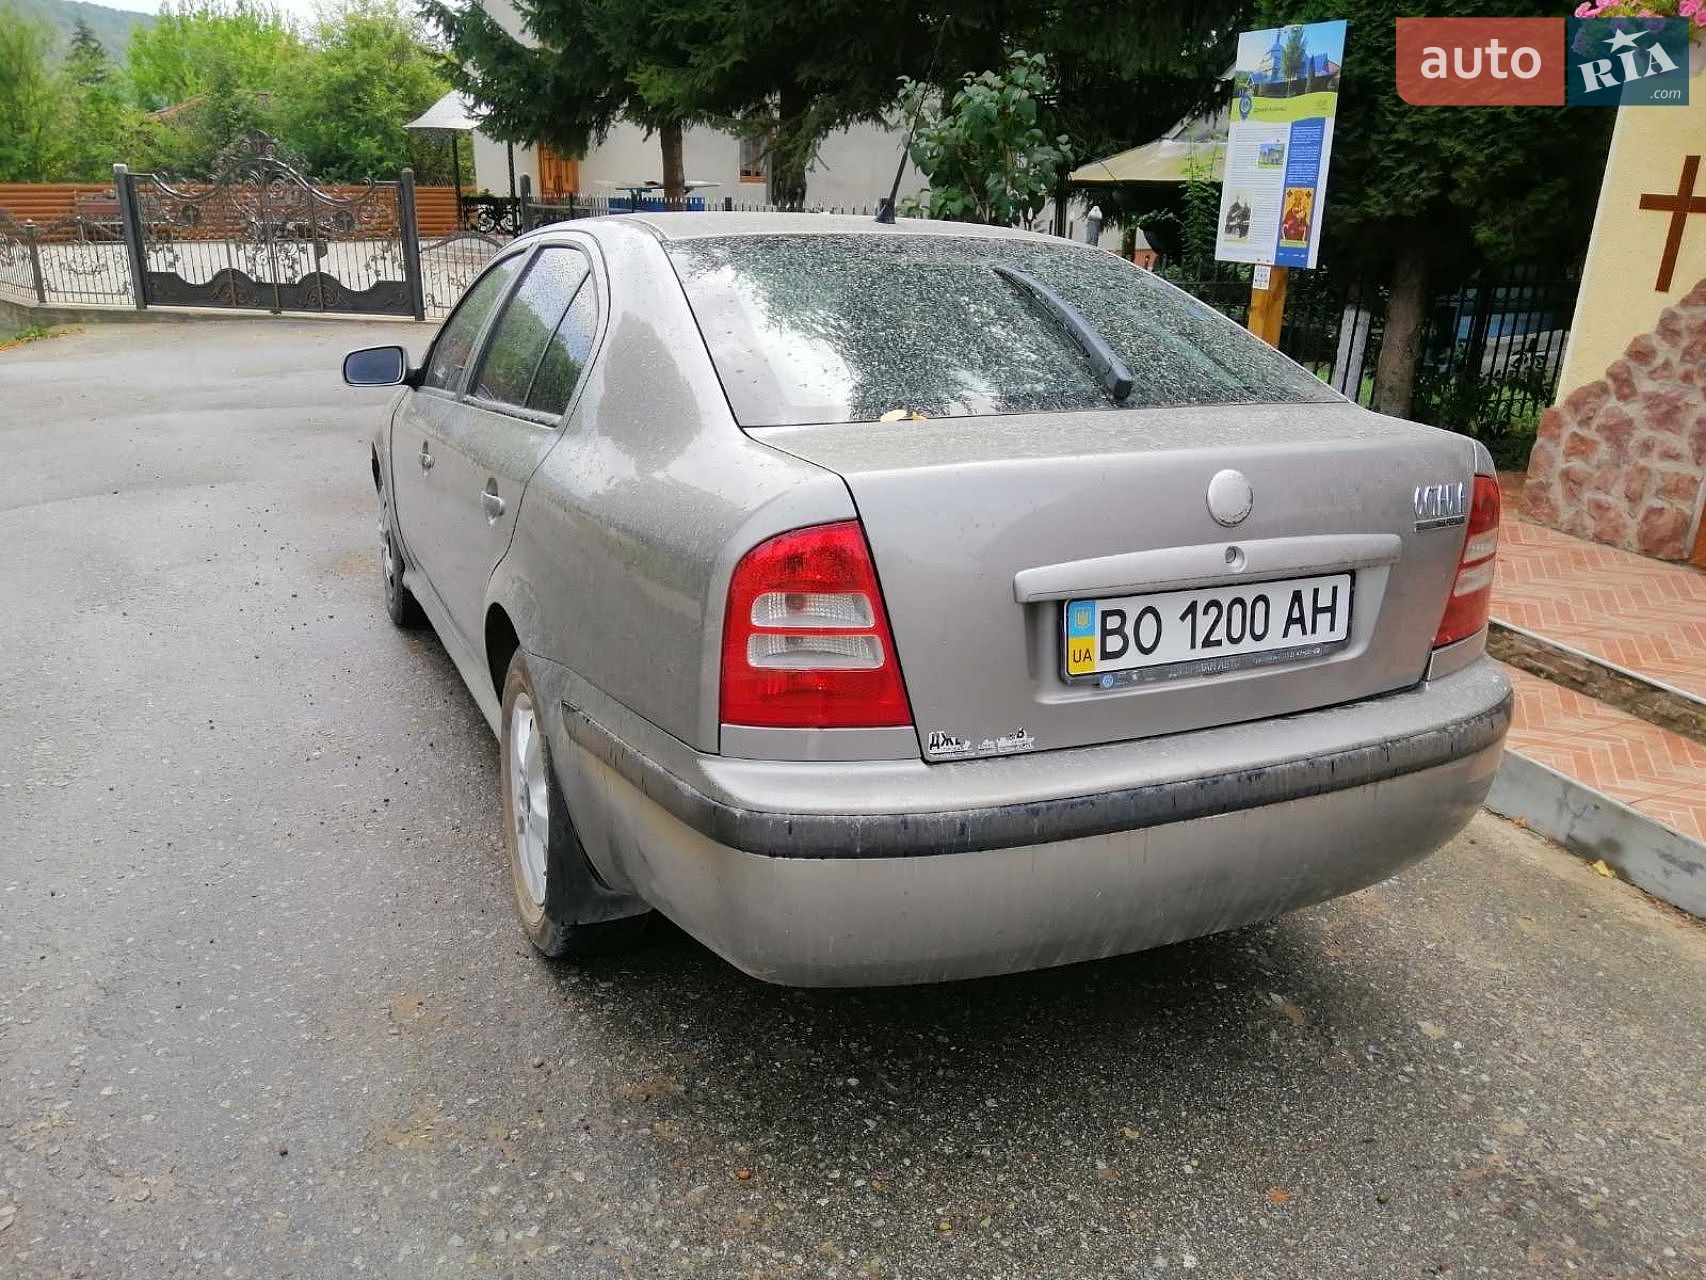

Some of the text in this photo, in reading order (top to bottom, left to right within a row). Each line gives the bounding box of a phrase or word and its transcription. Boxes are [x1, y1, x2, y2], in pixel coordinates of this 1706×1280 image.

[1100, 585, 1339, 661] BO 1200 AH
[1073, 648, 1092, 663] UA
